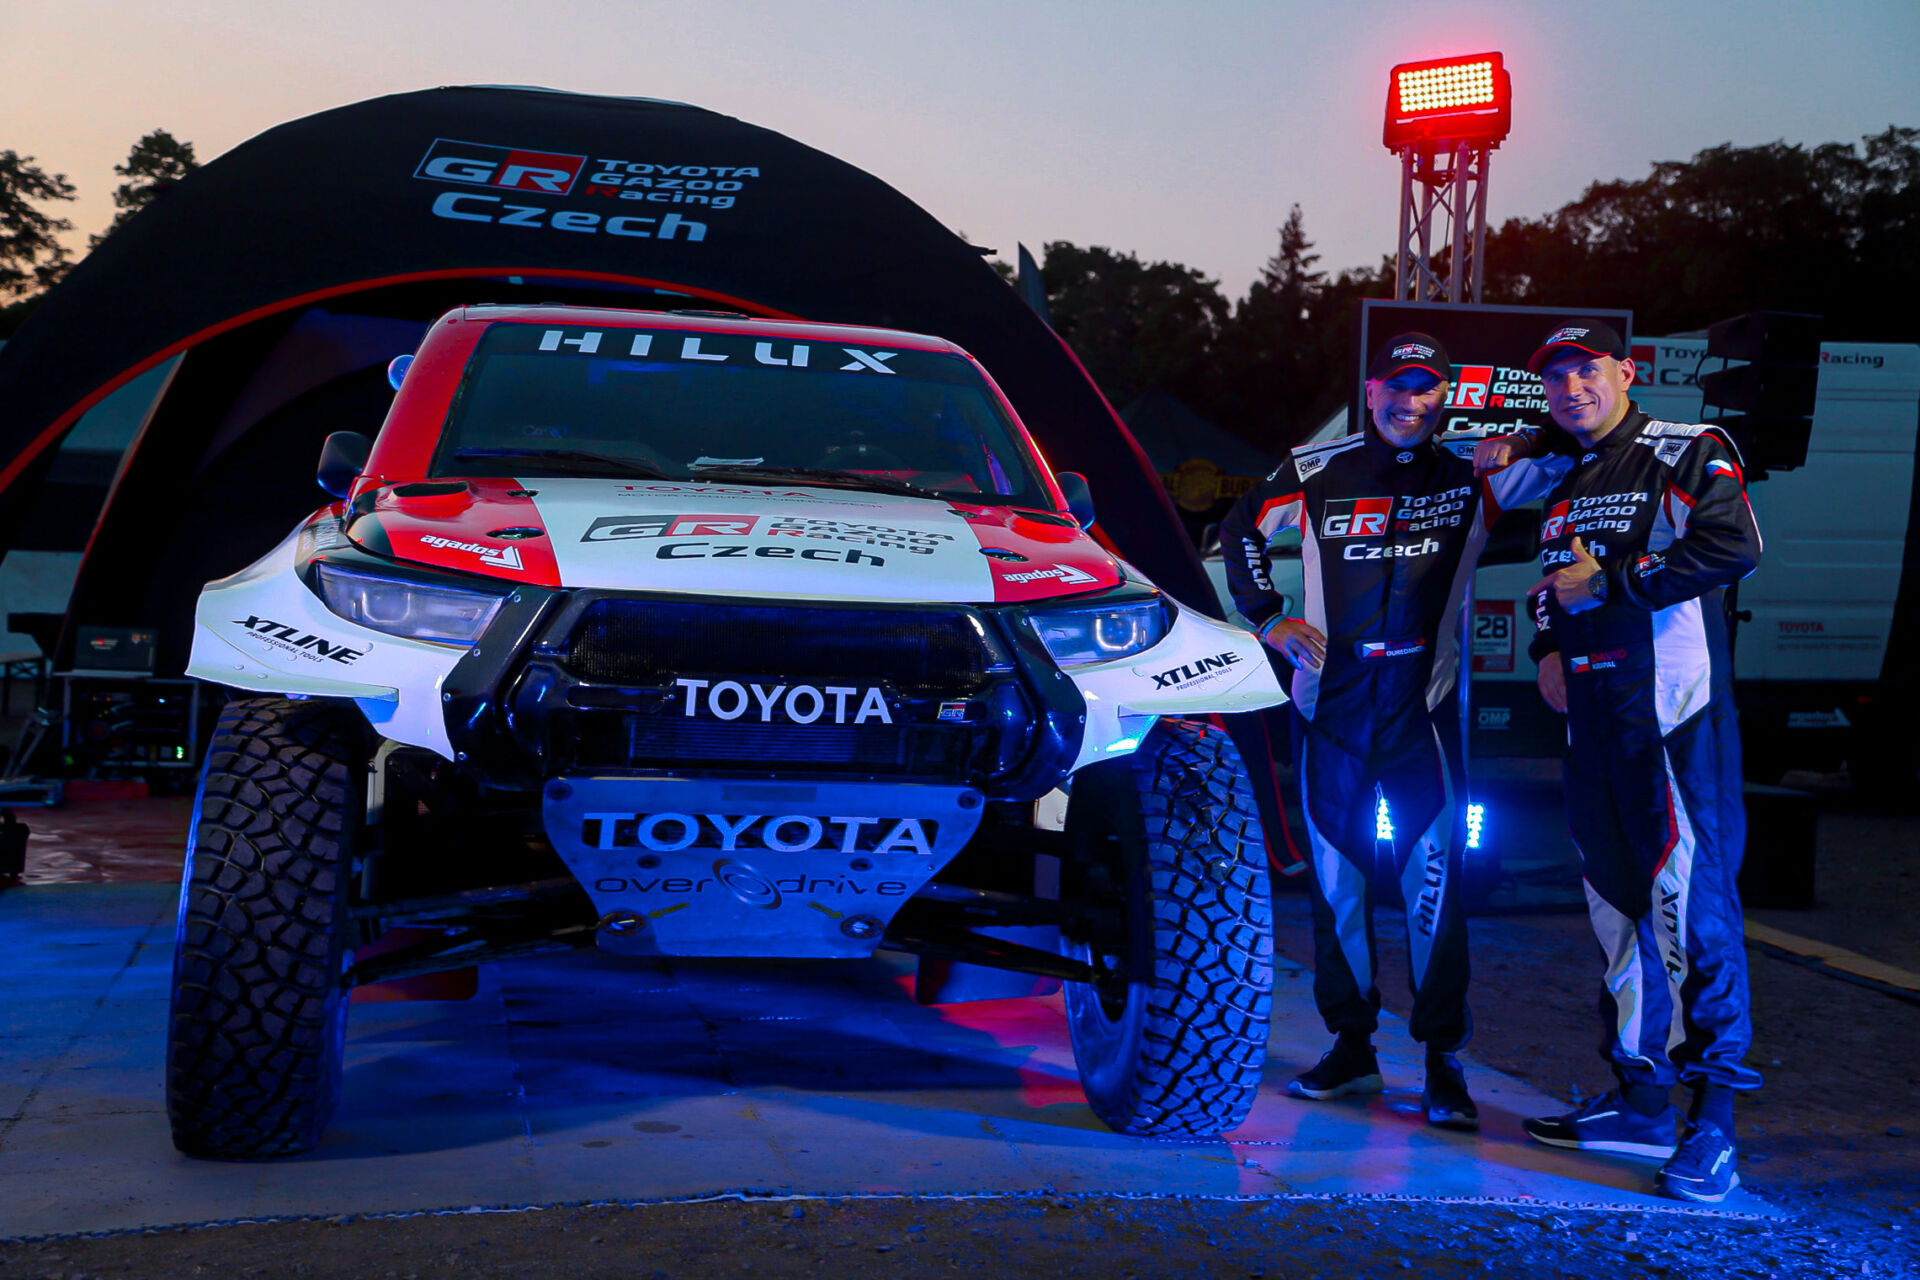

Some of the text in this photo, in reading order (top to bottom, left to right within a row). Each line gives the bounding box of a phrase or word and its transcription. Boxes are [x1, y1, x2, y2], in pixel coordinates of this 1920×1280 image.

[424, 157, 571, 192] GR
[596, 159, 761, 178] TOYOTA
[590, 174, 744, 191] GAZOO
[585, 185, 736, 209] Racing
[432, 192, 708, 241] Czech
[538, 330, 899, 375] HILUX
[1492, 382, 1546, 395] GAZO
[1489, 395, 1550, 413] Racing
[1457, 446, 1476, 455] OM
[1300, 457, 1321, 472] OMP
[613, 485, 820, 498] TOYOTA
[1573, 492, 1649, 509] TOYOTA
[1396, 500, 1464, 519] GAZOO
[1566, 506, 1637, 523] GAZOO
[591, 522, 753, 541] GR
[773, 516, 956, 541] TOYOTA
[1323, 513, 1386, 536] GR
[1394, 514, 1462, 533] Racing
[1542, 516, 1565, 540] R
[1564, 518, 1632, 536] Racing
[767, 529, 935, 554] Racing
[770, 523, 939, 546] GAZOO
[420, 534, 502, 557] agados
[656, 543, 886, 567] Czech
[1343, 538, 1440, 561] Czech
[1542, 541, 1607, 567] Czeh
[1002, 568, 1066, 584] agados
[1477, 615, 1508, 638] 28
[1778, 621, 1824, 633] TOYOTA
[246, 631, 298, 654] PROFESSIONAL
[299, 651, 325, 664] TOOLS
[1215, 667, 1233, 678] TOOLS
[1176, 674, 1215, 691] PROFESSIONAL
[676, 678, 893, 724] TOYOTA
[1478, 712, 1511, 726] OMP
[583, 812, 932, 855] TOYOTA
[1418, 843, 1445, 936] HILUX
